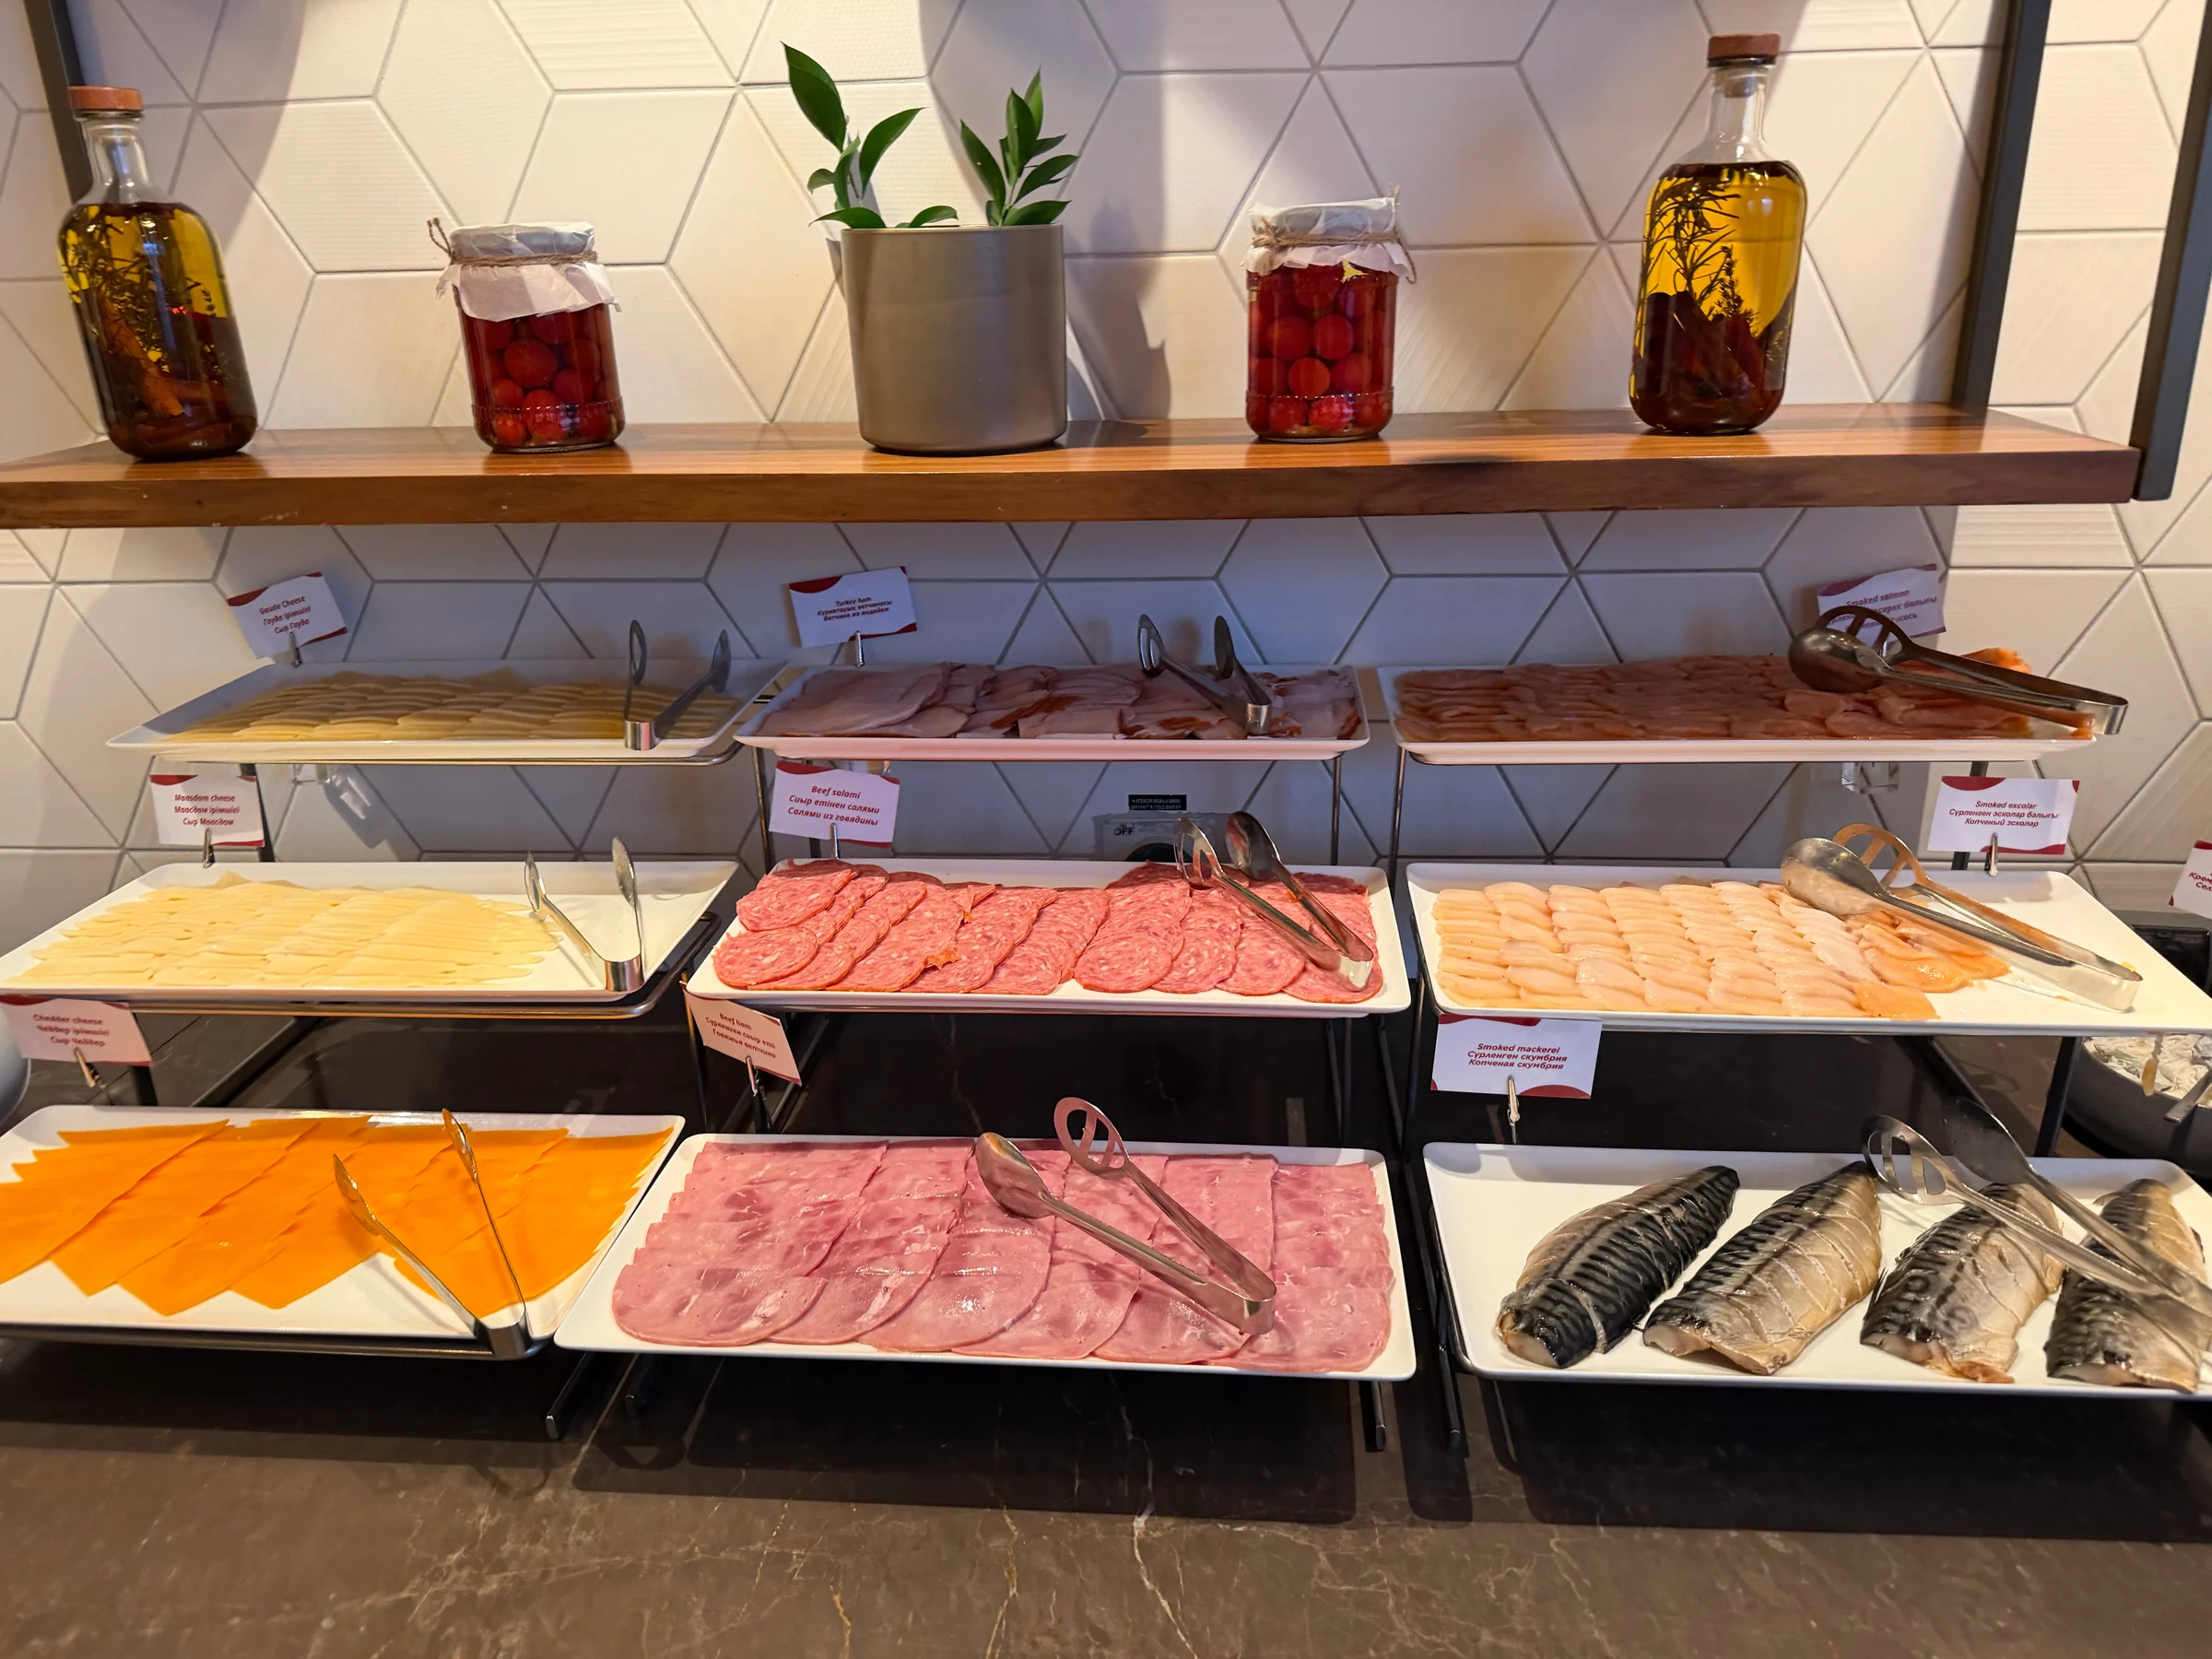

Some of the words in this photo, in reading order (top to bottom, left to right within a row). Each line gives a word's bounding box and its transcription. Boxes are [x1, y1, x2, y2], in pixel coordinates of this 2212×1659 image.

[282, 595, 306, 608] Cheese
[1879, 590, 1910, 601] salmon
[811, 785, 831, 796] Beef
[832, 789, 861, 799] salami
[789, 794, 813, 806] Сиыр
[815, 799, 846, 809] етінен
[848, 805, 879, 814] салями
[1975, 800, 2007, 808] Smoked
[182, 818, 198, 827] Сыр
[788, 807, 822, 818] Салями
[835, 816, 877, 826] говядины
[719, 1013, 735, 1025] Beef
[735, 1019, 752, 1030] ham
[743, 1032, 761, 1043] сиыр
[745, 1042, 776, 1058] ветчина
[1477, 1043, 1515, 1052] Smoked
[1517, 1045, 1560, 1053] mackerel
[1469, 1058, 1514, 1067] Копченая
[1517, 1061, 1563, 1070] скумбрия
[1521, 1053, 1567, 1063] скумбрия
